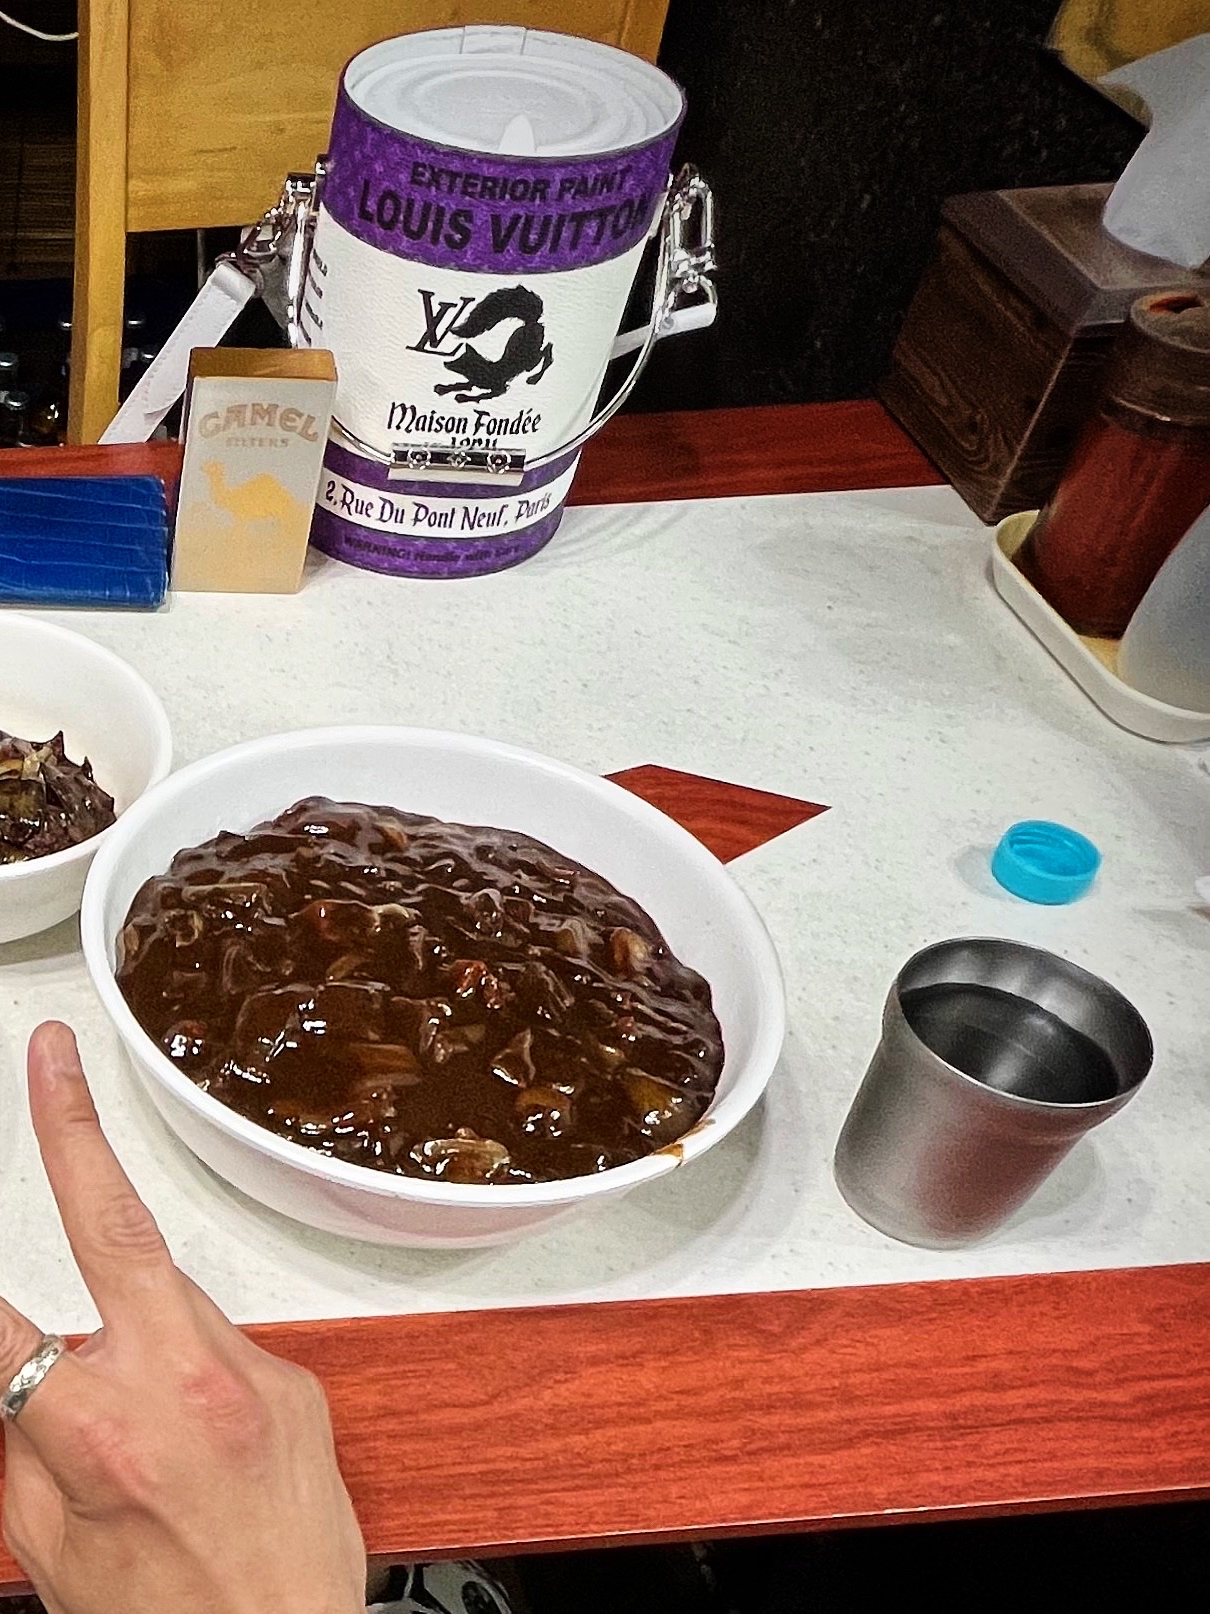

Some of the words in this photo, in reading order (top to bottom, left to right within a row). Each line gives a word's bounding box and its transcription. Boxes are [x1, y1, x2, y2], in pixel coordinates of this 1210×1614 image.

[410, 161, 551, 202] EXTERIOR
[556, 163, 634, 201] PAINT
[356, 178, 475, 250] LOUIS
[198, 402, 319, 442] CAMEL
[387, 401, 469, 434] Maison
[472, 407, 542, 436] Fondée
[376, 496, 405, 524] Du
[412, 501, 456, 529] Pont
